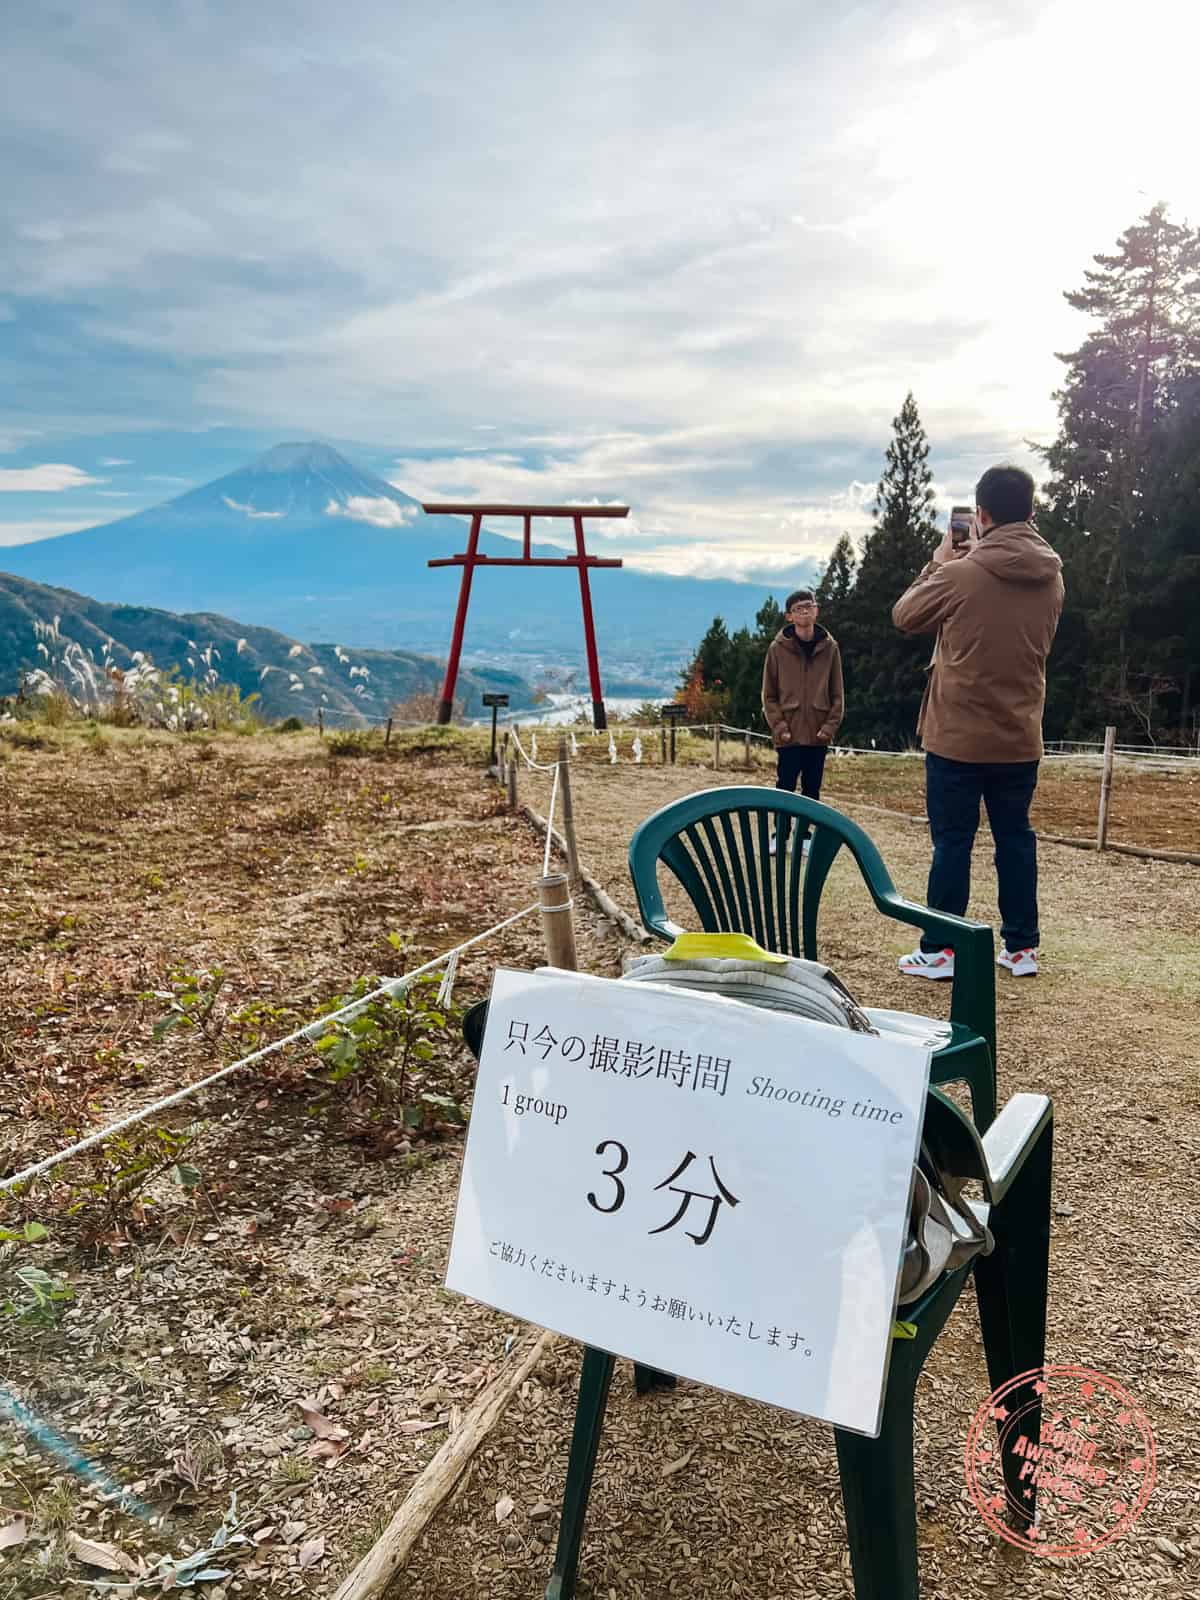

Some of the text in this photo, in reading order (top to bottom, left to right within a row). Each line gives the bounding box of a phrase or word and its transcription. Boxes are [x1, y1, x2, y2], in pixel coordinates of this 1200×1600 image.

[502, 1085, 568, 1124] 1 group
[503, 1020, 904, 1125] 只今の撮影時間 Shooting time
[488, 1240, 814, 1358] ご協力くださいますようお願いいたします。
